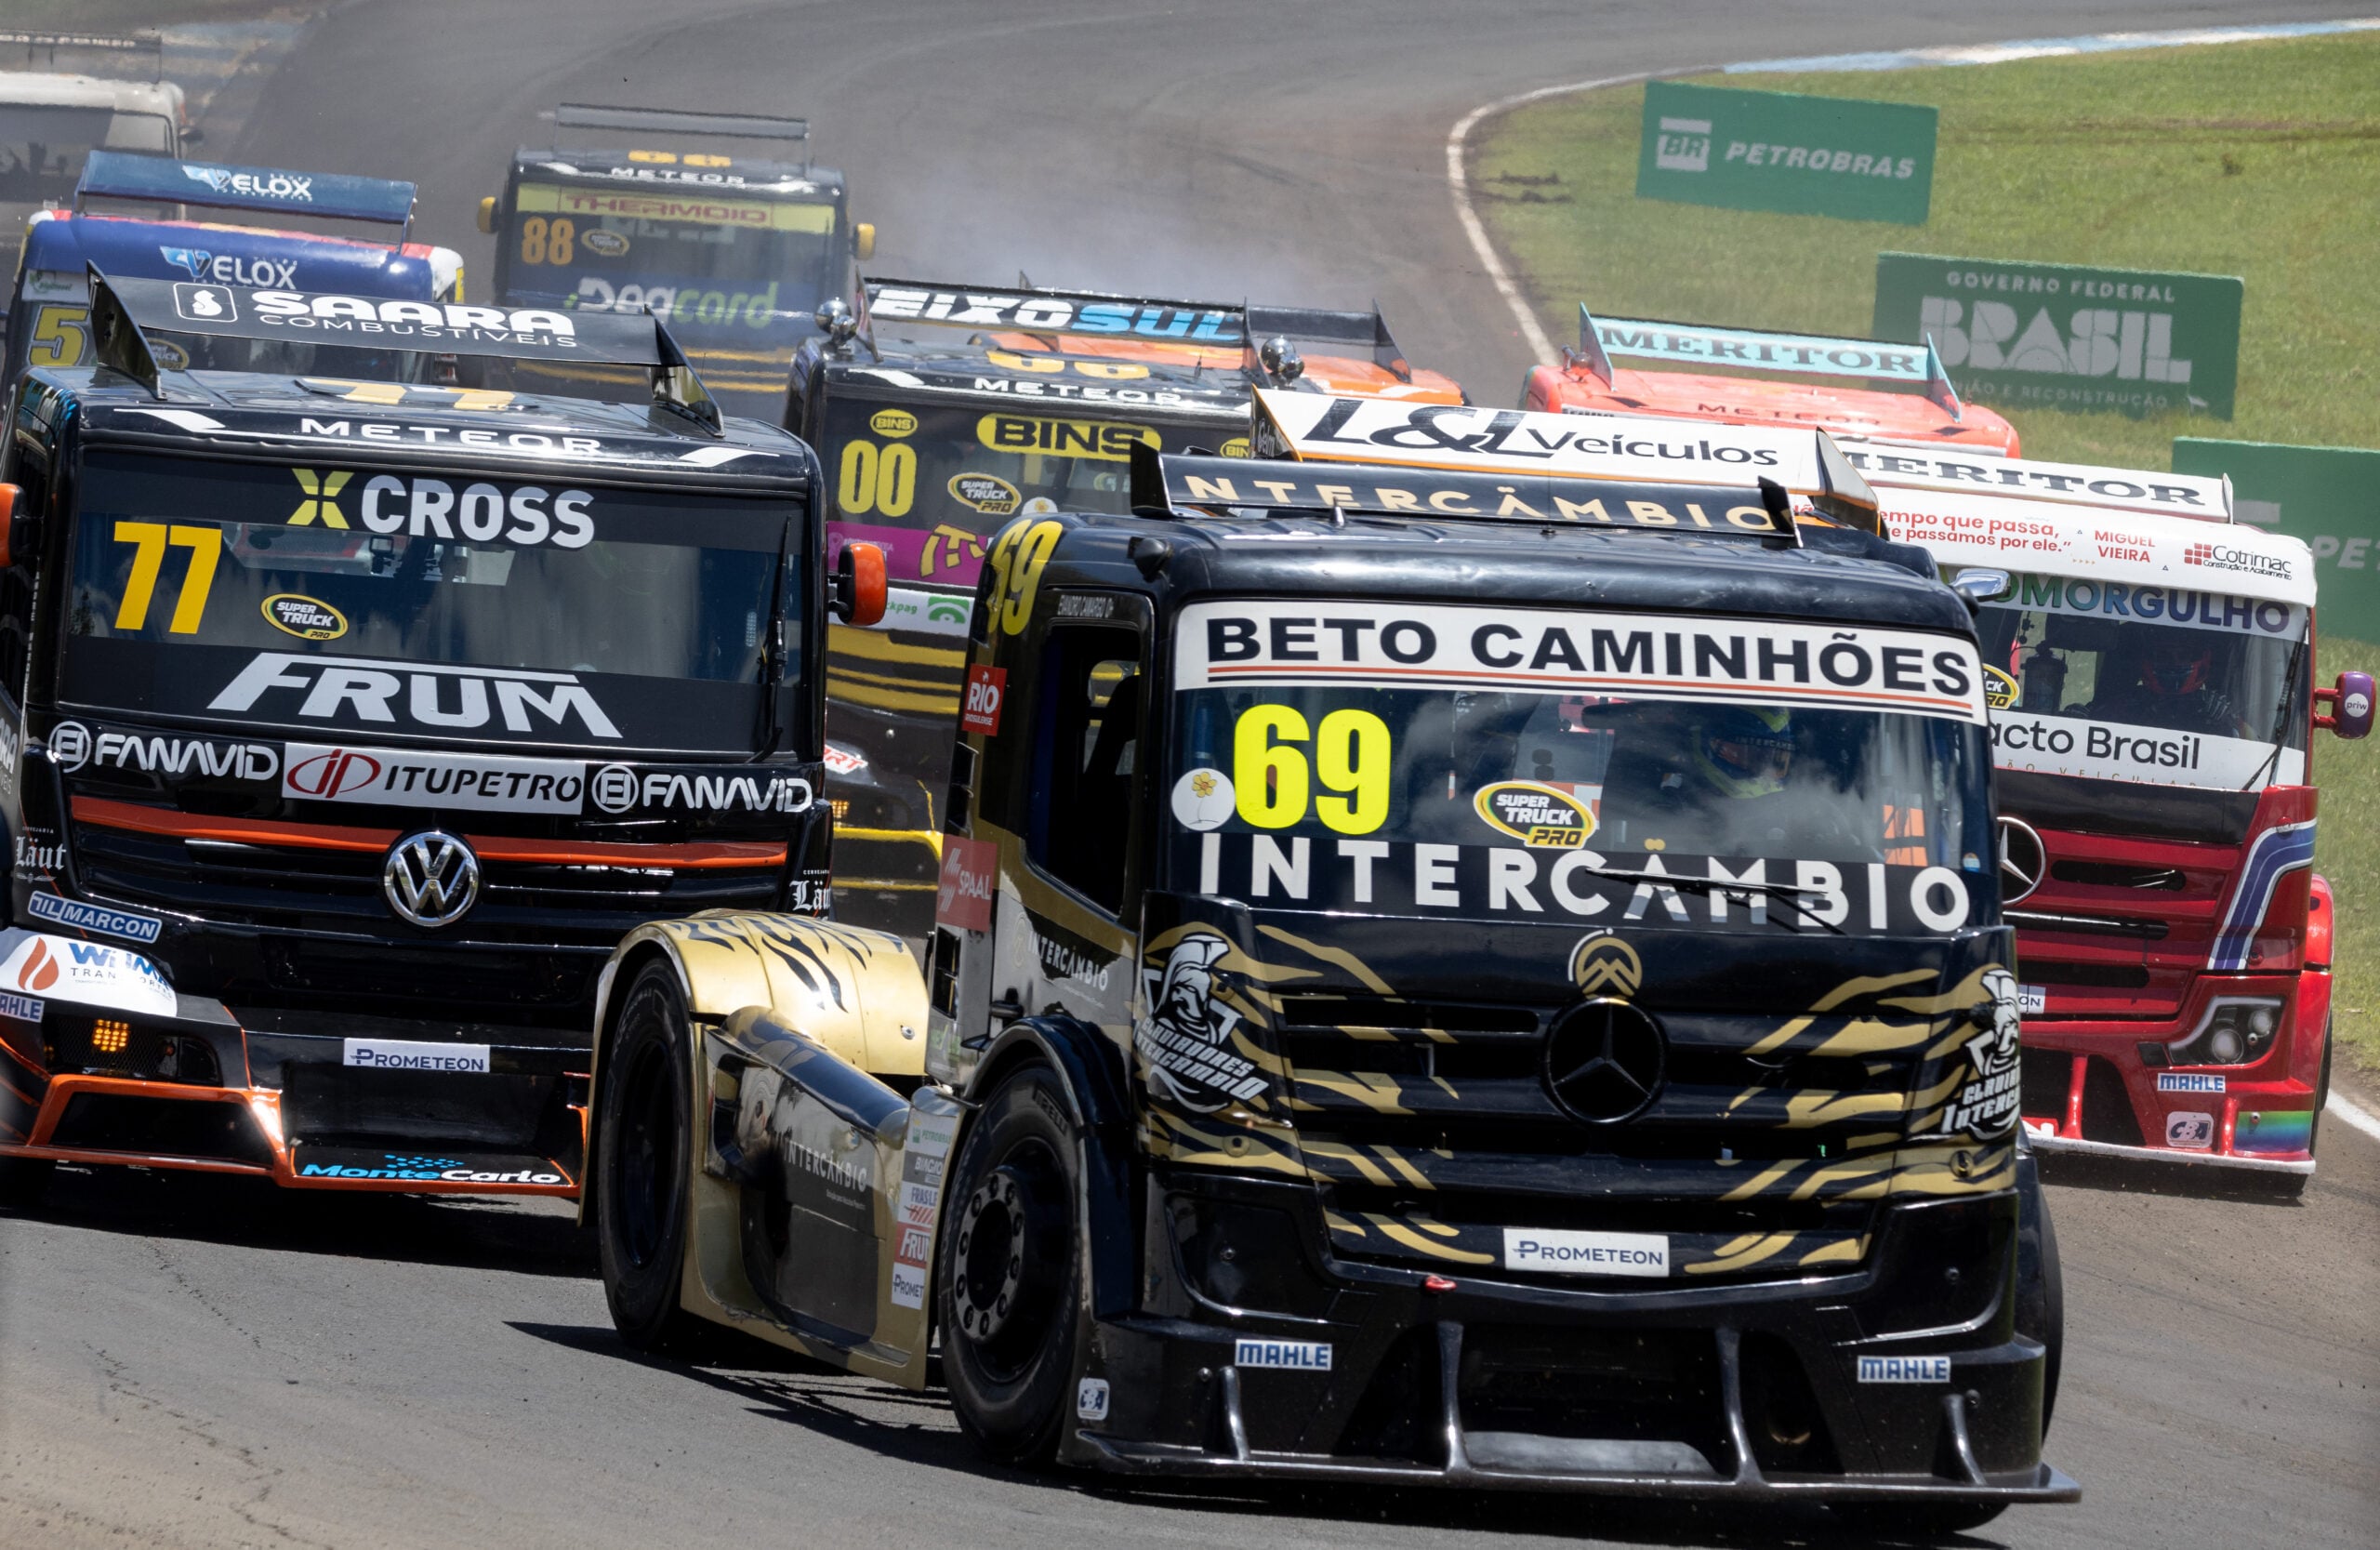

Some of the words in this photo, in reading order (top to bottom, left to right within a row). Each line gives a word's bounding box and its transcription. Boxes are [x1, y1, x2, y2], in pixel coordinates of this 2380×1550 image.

[1726, 141, 1915, 179] PETROBRAS
[611, 167, 744, 185] METEOR
[566, 193, 766, 223] THERMOID
[522, 217, 575, 265] 88
[160, 245, 297, 289] VELOX
[1947, 272, 2060, 294] GOVERNO
[2070, 280, 2175, 303] FEDERAL
[252, 291, 575, 336] SAARA
[870, 289, 1240, 341] EIXOSUL
[28, 305, 88, 365] 5
[260, 315, 576, 348] COMBUSTÍVEIS
[1919, 295, 2192, 383] BRASIL
[1598, 326, 1921, 373] MERITOR
[974, 377, 1182, 405] METEOR
[2022, 385, 2168, 409] RECONSTRUÇÃO
[301, 417, 601, 456] METEOR
[874, 417, 911, 431] BINS
[994, 417, 1144, 455] BINS
[1302, 398, 1556, 458] L&L
[1526, 426, 1778, 467] Veículos
[838, 439, 917, 517] 00
[960, 479, 995, 491] SUPER
[965, 488, 1009, 500] TRUCK
[980, 501, 1012, 512] PRO
[1906, 527, 1996, 546] passamos
[2001, 537, 2029, 550] por
[1943, 516, 1984, 532] que
[1989, 519, 2060, 538] passa,
[2094, 530, 2156, 548] MIGUEL
[2097, 545, 2150, 563] VIEIRA
[2213, 545, 2292, 574] Cotrimac
[114, 522, 222, 634] 77
[277, 601, 316, 615] SUPER
[282, 610, 334, 628] TRUCK
[310, 630, 331, 640] PRO
[1208, 617, 1436, 664] BETO
[1470, 624, 1971, 697] CAMINHÕES
[206, 652, 624, 738] FRUM
[967, 682, 999, 714] RIO
[96, 733, 278, 781] FANAVID
[2086, 726, 2201, 770] Brasil
[384, 765, 582, 802] ITUPETRO
[1234, 704, 1392, 835] 69
[642, 774, 813, 813] FANAVID
[1496, 794, 1550, 809] SUPER
[1504, 807, 1575, 826] TRUCK
[1532, 828, 1582, 846] PRO
[958, 870, 991, 900] SPAAL
[63, 905, 157, 939] MARCON
[350, 1048, 484, 1071] PROMETEON
[2160, 1075, 2224, 1092] MAHLE
[302, 1163, 561, 1184] MonteCarlo
[1513, 1239, 1663, 1268] PROMETEON
[1238, 1344, 1330, 1369] MAHLE
[1861, 1358, 1947, 1380] MAHLE
